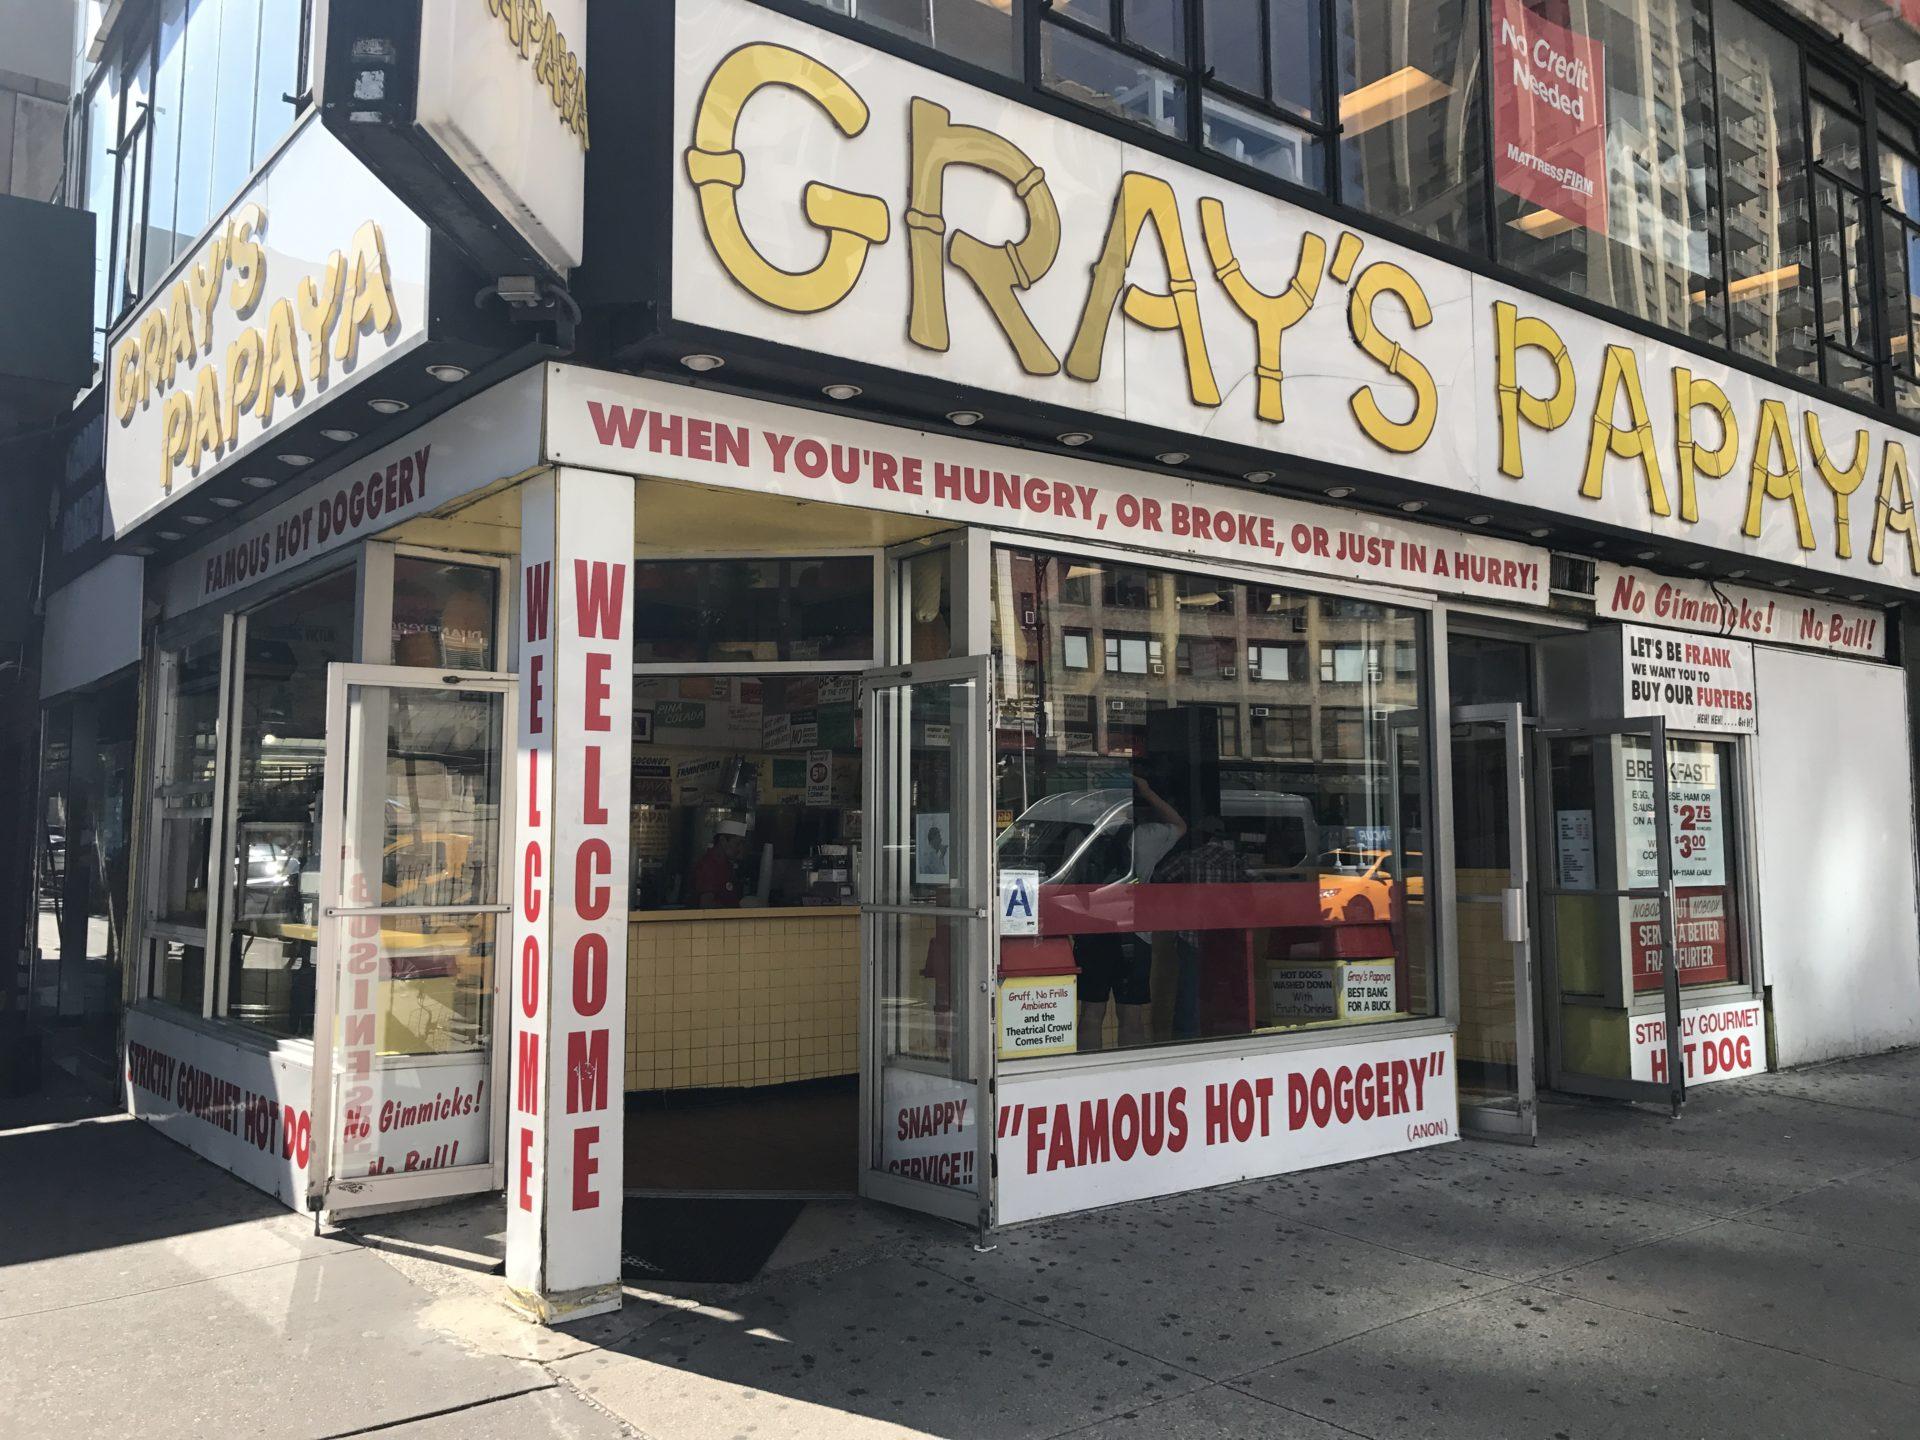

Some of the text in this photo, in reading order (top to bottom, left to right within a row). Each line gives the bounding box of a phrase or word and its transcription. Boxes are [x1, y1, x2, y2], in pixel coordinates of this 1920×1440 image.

[1501, 18, 1589, 92] No Credit
[1513, 58, 1584, 122] Needed
[114, 202, 266, 424] GRAY'S
[684, 41, 1920, 576] GRAY'S PAPAYA
[160, 219, 395, 489] PAPAYA
[586, 400, 1539, 591] WHEN YOU'RE HUNGRY, OR BROKE, OR JUST IN A HURRY!
[205, 444, 432, 594] FAMOUS HOT DOGGERY
[1611, 575, 1876, 650] No Gimmicks! No Bull!
[1631, 636, 1732, 668] LET'S BE FRANK
[1631, 663, 1710, 682] WE WANT YOU TO
[1631, 680, 1752, 710] BUY OUR FURTERS
[1626, 760, 1710, 781] BREKFAST
[1684, 792, 1699, 800] HAM
[1701, 793, 1710, 801] OR
[1633, 817, 1645, 825] ON
[1647, 817, 1652, 825] A
[566, 559, 626, 1212] WELCOME
[1637, 869, 1659, 877] SERVE
[518, 561, 550, 1213] WELCOME
[1006, 878, 1032, 916] A
[1632, 903, 1660, 917] NOBOD
[1676, 898, 1688, 918] UT
[1678, 923, 1686, 942] A
[1688, 920, 1719, 942] BETTER
[1645, 946, 1714, 972] FRAFURTER
[1273, 980, 1332, 989] WASHED DOWN
[1281, 970, 1322, 979] HOT DOGS
[1347, 970, 1391, 985] Gray's Papaya
[1036, 990, 1047, 999] No
[1049, 988, 1068, 998] Frills
[1293, 992, 1313, 1001] With
[1347, 987, 1388, 997] BEST BANG
[1021, 1001, 1057, 1011] Ambience
[1024, 1012, 1055, 1023] and the
[1275, 1002, 1333, 1016] Fruity Drinks
[1348, 1001, 1391, 1011] FOR A BUCK
[1006, 1022, 1072, 1036] Theatrical Crowd
[1636, 1008, 1759, 1044] STRILY GOURMET
[1015, 1034, 1065, 1046] Comes Free!
[1651, 1035, 1752, 1083] HT DOG
[128, 1040, 311, 1169] STRICTLY GOURMET HOT DO
[344, 1080, 484, 1142] No Gimmicks!
[1205, 1077, 1273, 1146] HOT
[897, 1099, 968, 1141] SNAPPY
[1406, 1117, 1448, 1143] (ANON)
